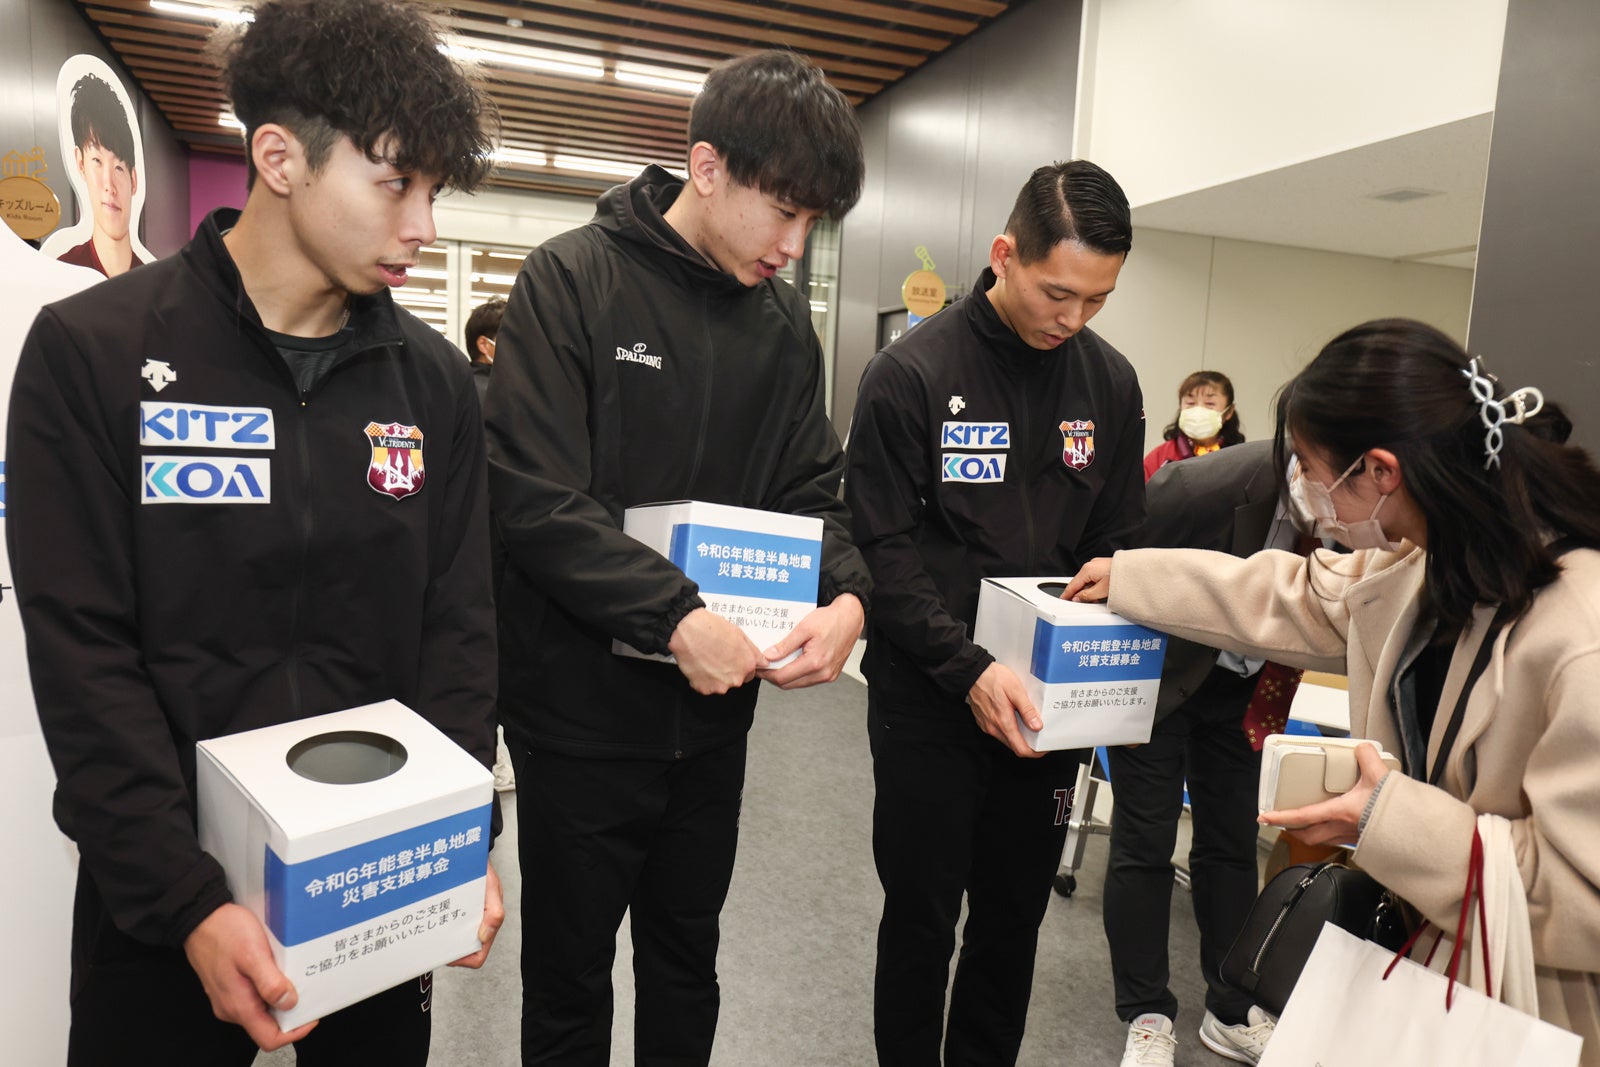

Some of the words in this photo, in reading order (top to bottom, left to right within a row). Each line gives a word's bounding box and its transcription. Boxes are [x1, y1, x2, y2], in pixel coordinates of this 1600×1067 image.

[615, 347, 662, 370] SPALDING
[141, 406, 269, 444] KITZ
[943, 424, 1008, 446] KITZ
[144, 461, 265, 498] KOA
[943, 456, 1001, 480] KOA
[696, 542, 812, 570] 令和6年能登半島地震
[717, 562, 790, 583] 災害支援募金
[711, 602, 789, 618] 皆さまからのご支援
[1061, 638, 1162, 653] 令和6年能登半島地震
[1078, 653, 1141, 667] 災害支援募金
[1053, 696, 1147, 711] ご協力をお願いいたします。
[1070, 686, 1138, 699] 皆さまからのご支援
[304, 825, 482, 898] 令和6年能登半島地震
[341, 856, 450, 909] 災害支援募金
[333, 897, 451, 952] 皆さまからのご支援
[304, 907, 467, 977] ご協力をお願いいたします。
